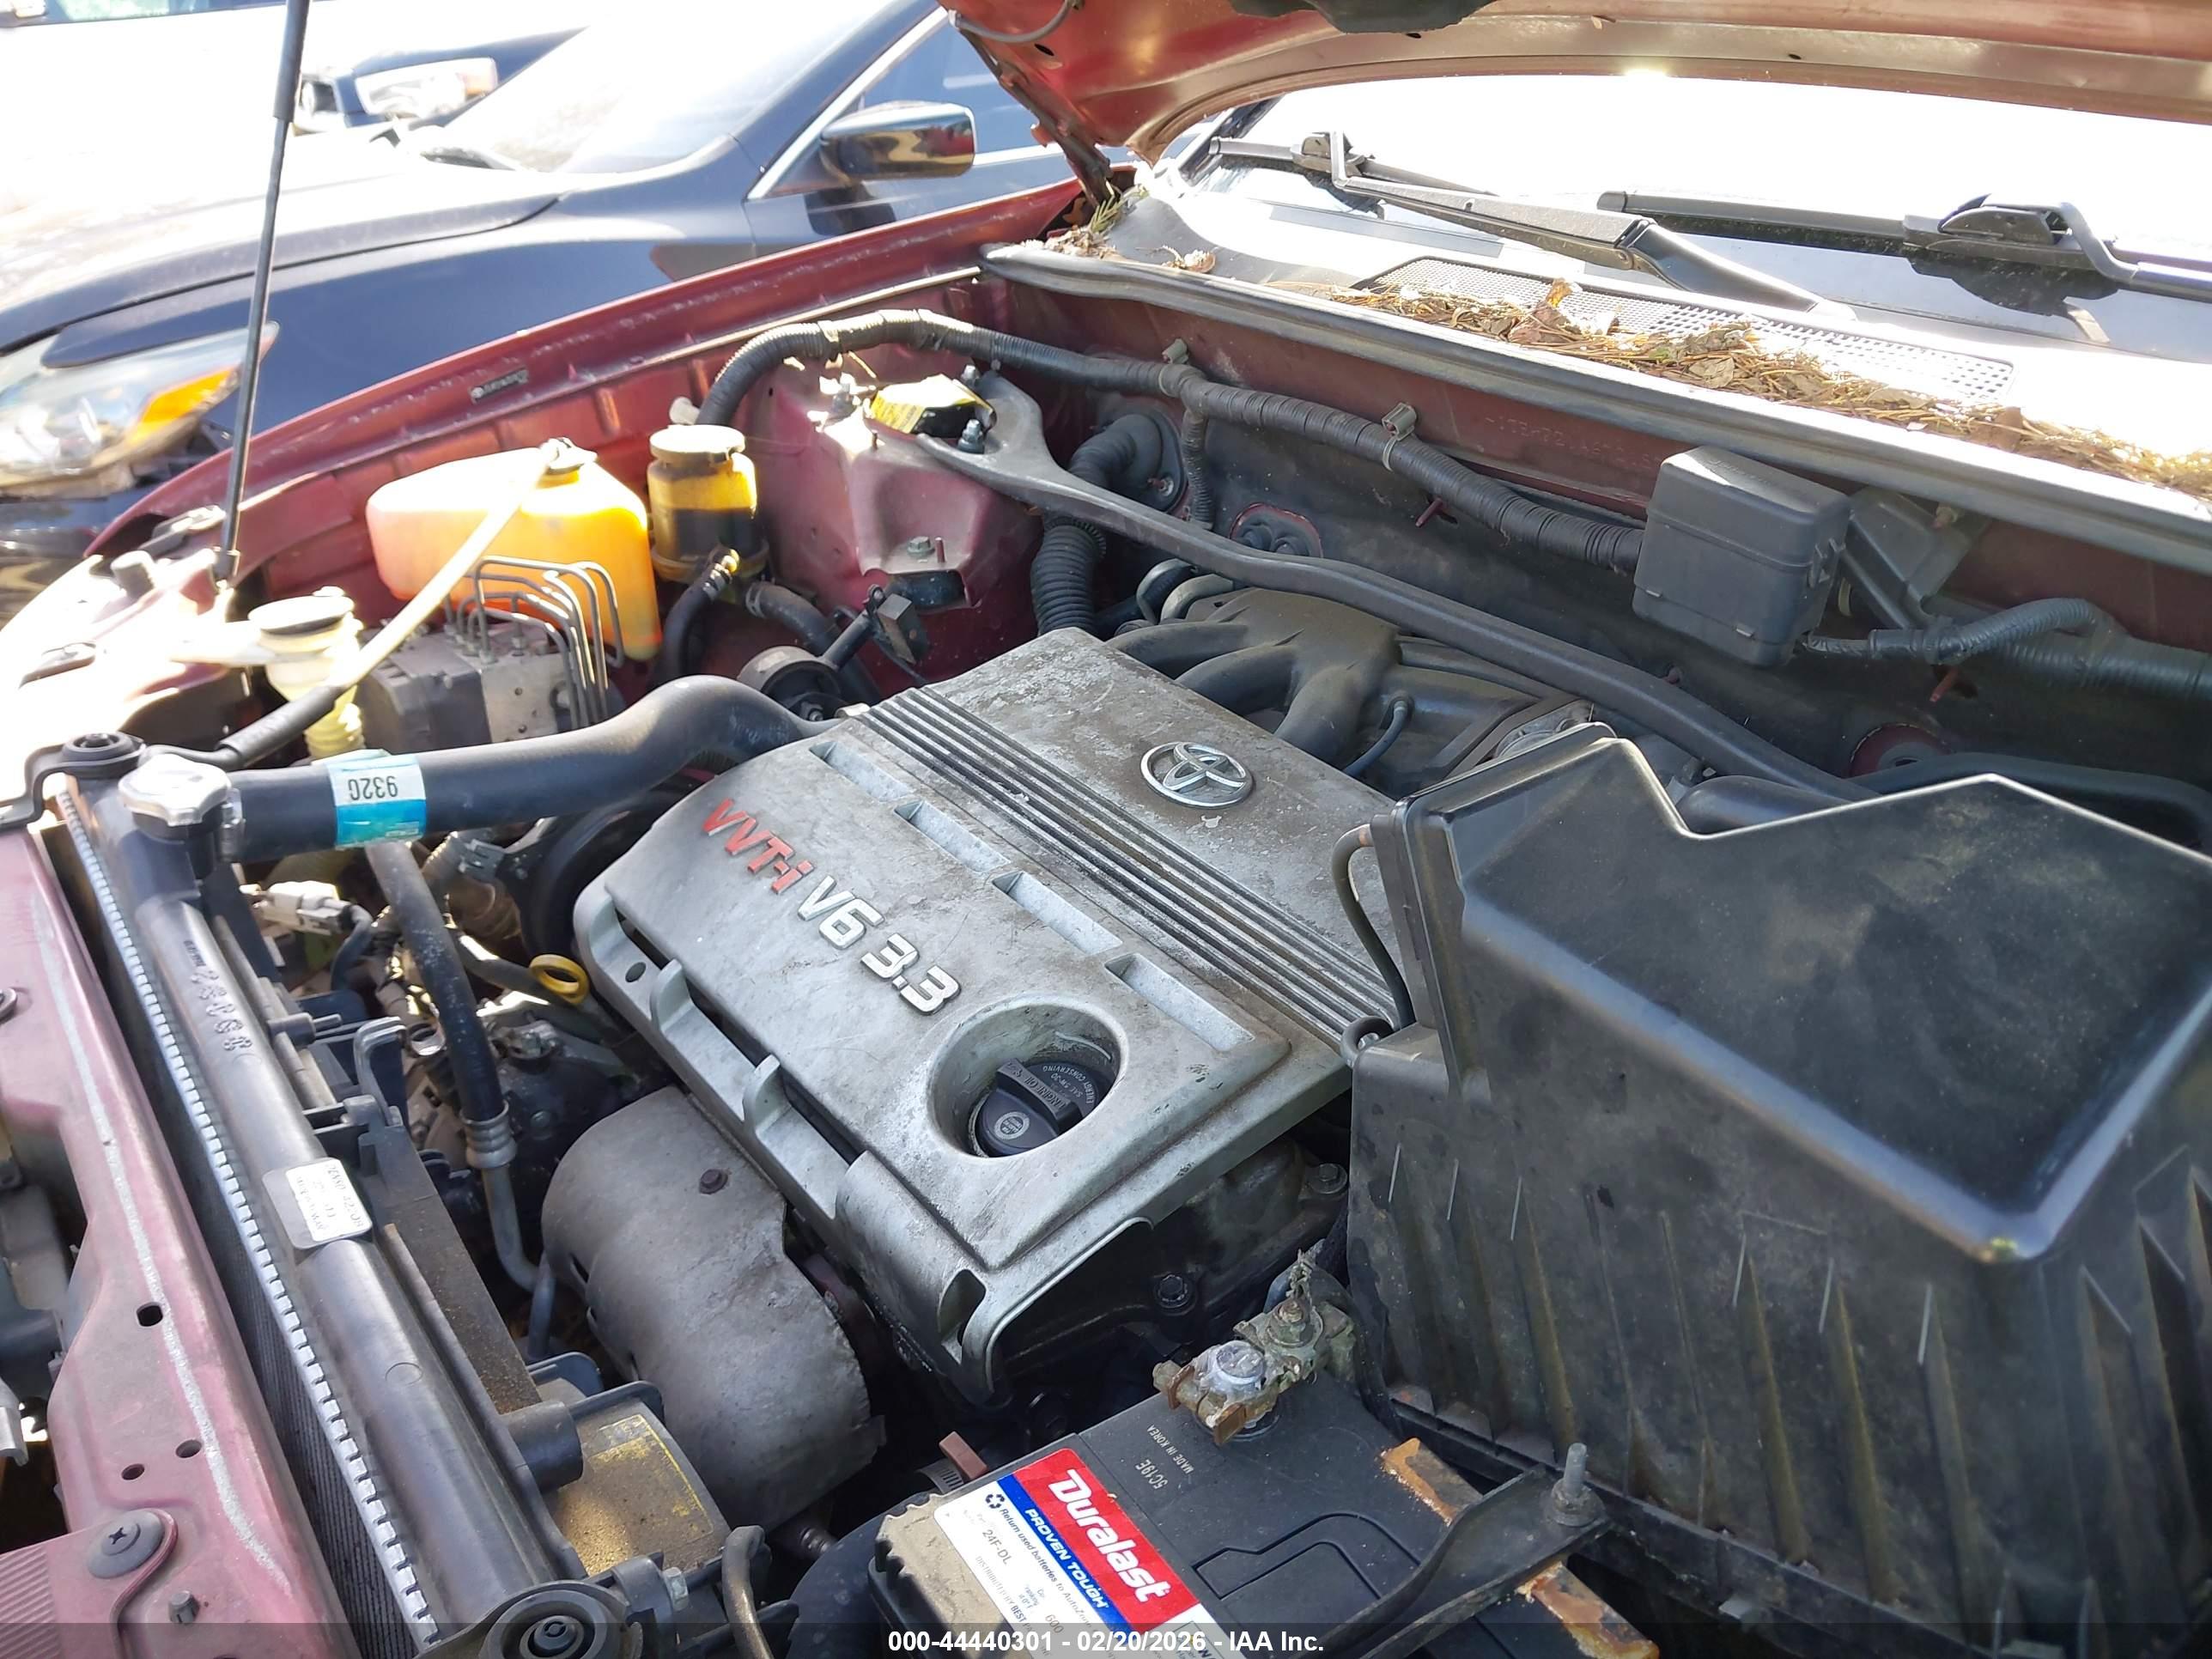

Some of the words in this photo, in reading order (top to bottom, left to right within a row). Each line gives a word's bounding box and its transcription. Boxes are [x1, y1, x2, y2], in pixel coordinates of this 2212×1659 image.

[702, 798, 815, 895] VVT-i
[797, 874, 885, 951] V6
[860, 933, 962, 1017] 3.3
[1146, 1424, 1170, 1448] KOREA
[1165, 1445, 1178, 1455] IN
[1135, 1459, 1169, 1489] 5C19E
[1173, 1453, 1194, 1474] MADE
[981, 1528, 1012, 1565] 24F-DL
[999, 1508, 1022, 1538] Return
[1018, 1533, 1038, 1552] used
[1030, 1549, 1058, 1583] batteries
[1055, 1583, 1065, 1592] to
[1048, 1468, 1172, 1603] Duralast
[1024, 1508, 1073, 1561] PROVEN
[1067, 1561, 1108, 1609] TOUGH
[1011, 1605, 1027, 1623] BEST
[1044, 1614, 1065, 1634] 600
